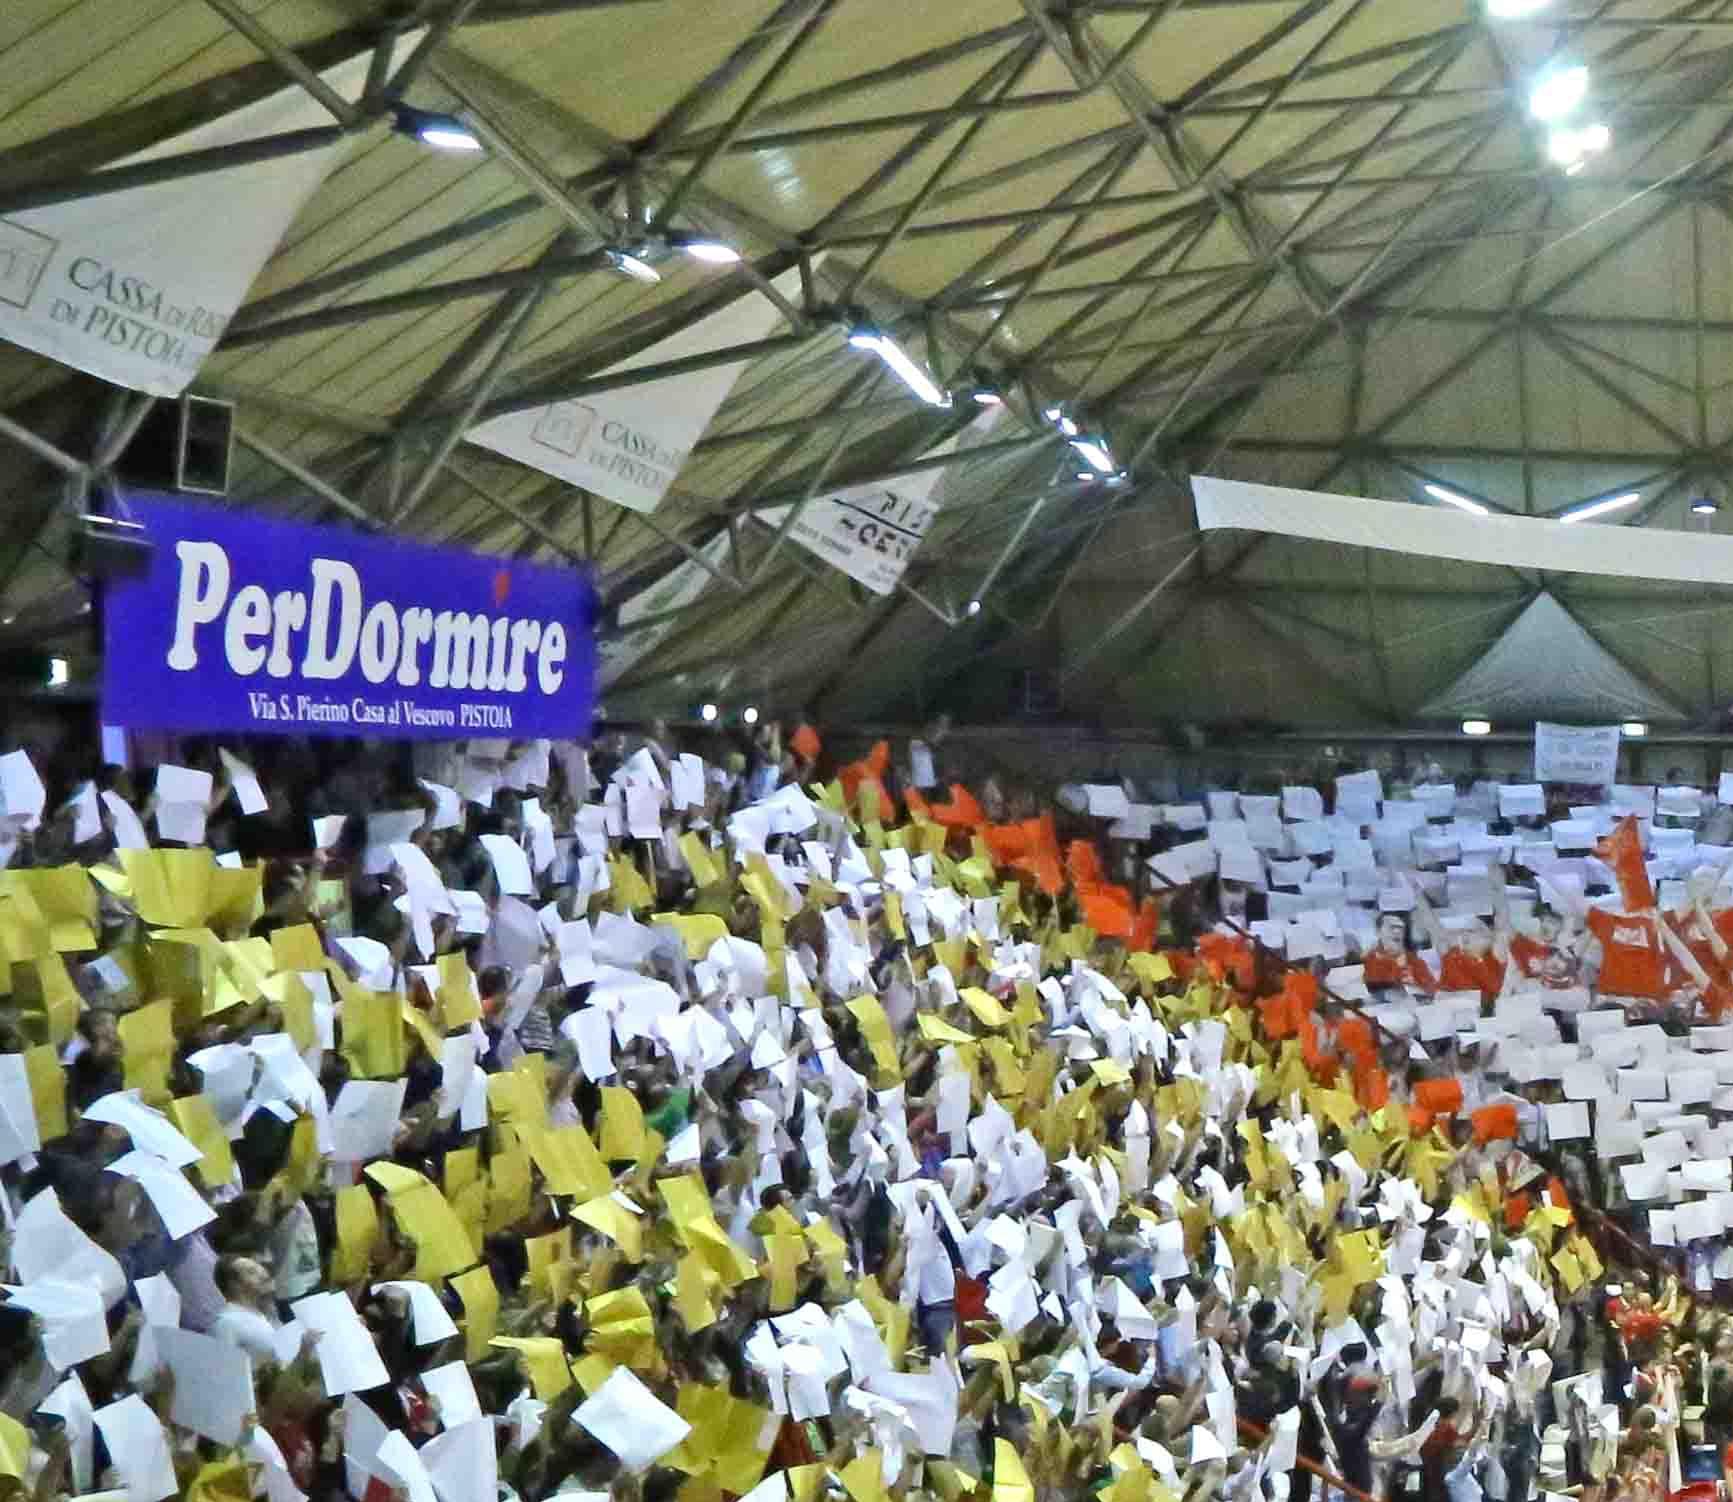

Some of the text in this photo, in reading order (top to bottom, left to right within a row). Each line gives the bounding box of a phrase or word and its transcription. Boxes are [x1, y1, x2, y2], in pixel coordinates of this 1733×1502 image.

[68, 257, 164, 320] CASSA
[167, 540, 567, 695] PerDormire
[248, 692, 512, 729] Via S. Pierino Casa al Vescovo PISTOIA
